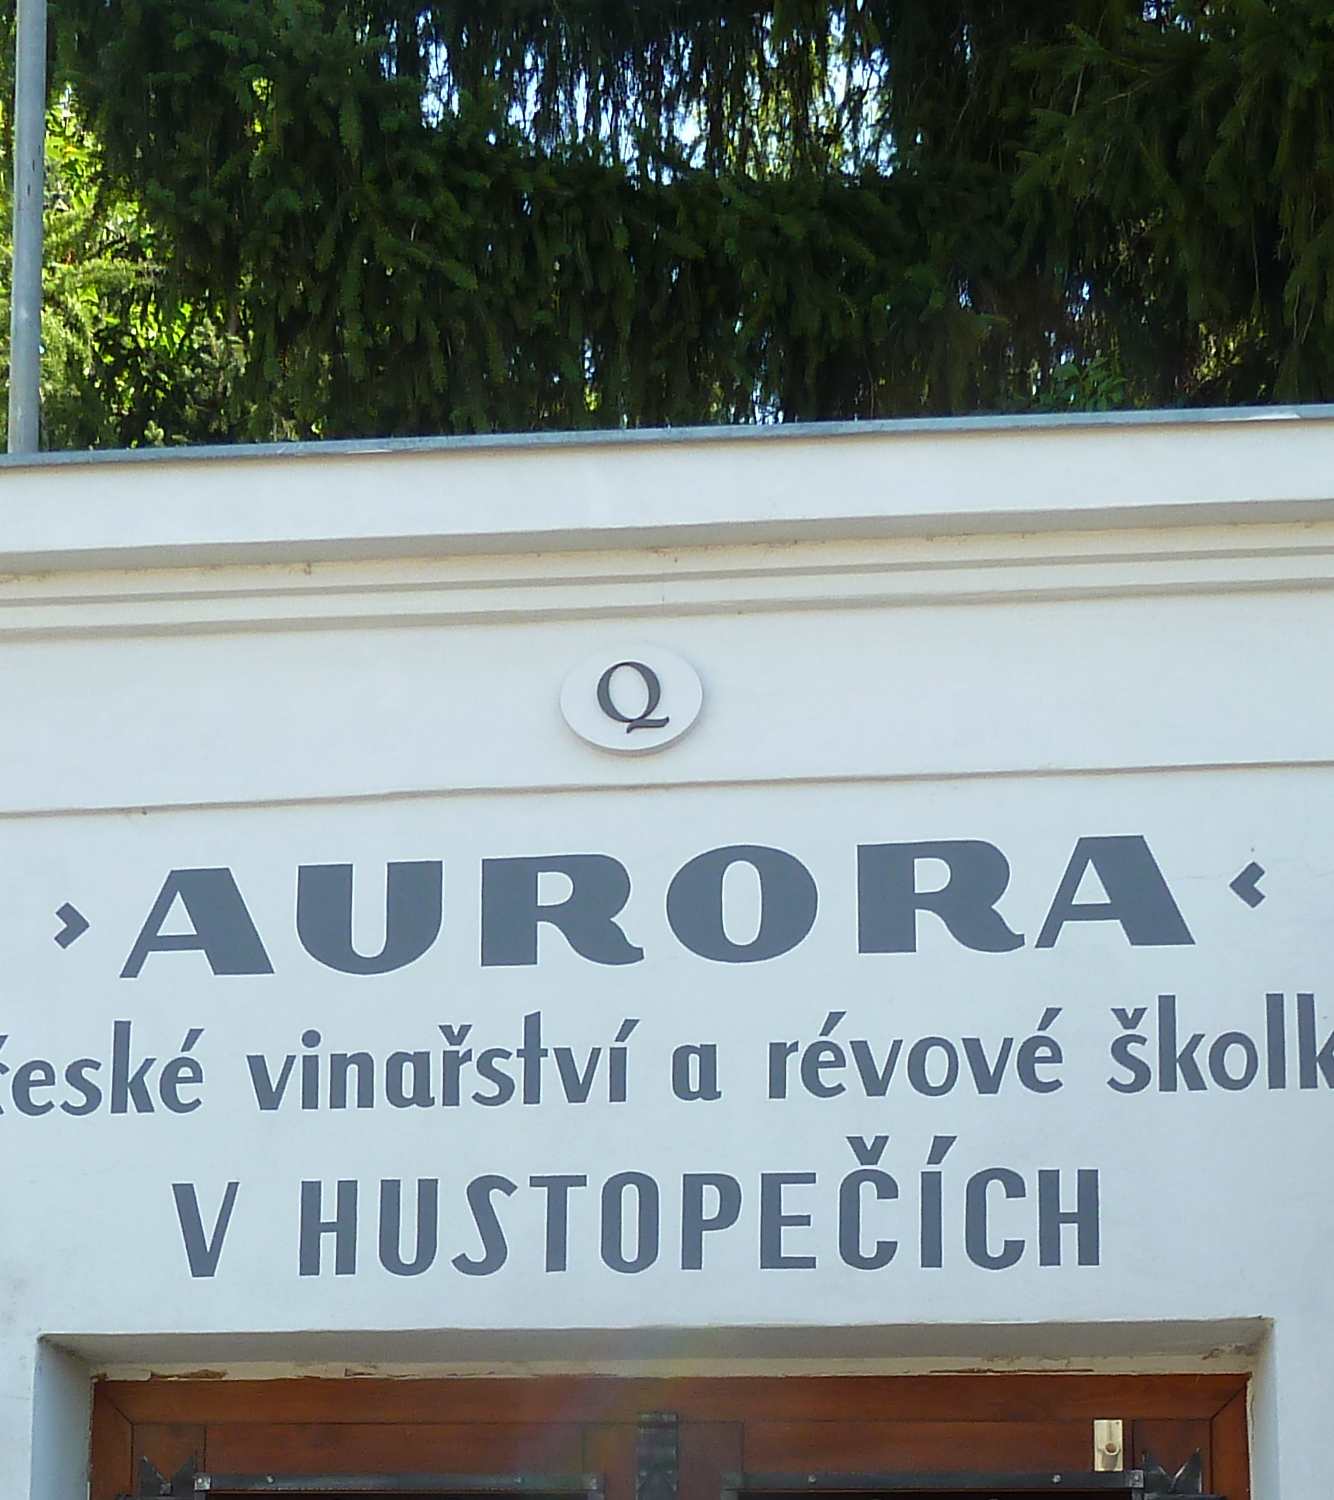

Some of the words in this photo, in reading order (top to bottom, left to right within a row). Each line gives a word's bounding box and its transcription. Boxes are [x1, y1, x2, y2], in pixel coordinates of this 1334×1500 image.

[595, 660, 671, 735] Q
[119, 834, 1196, 979] AURORA
[246, 1010, 640, 1111] vinařství
[671, 1043, 722, 1102] a
[768, 1007, 1064, 1100] révové
[171, 1181, 240, 1278] V
[299, 1135, 1101, 1277] HUSTOPEČÍCH
